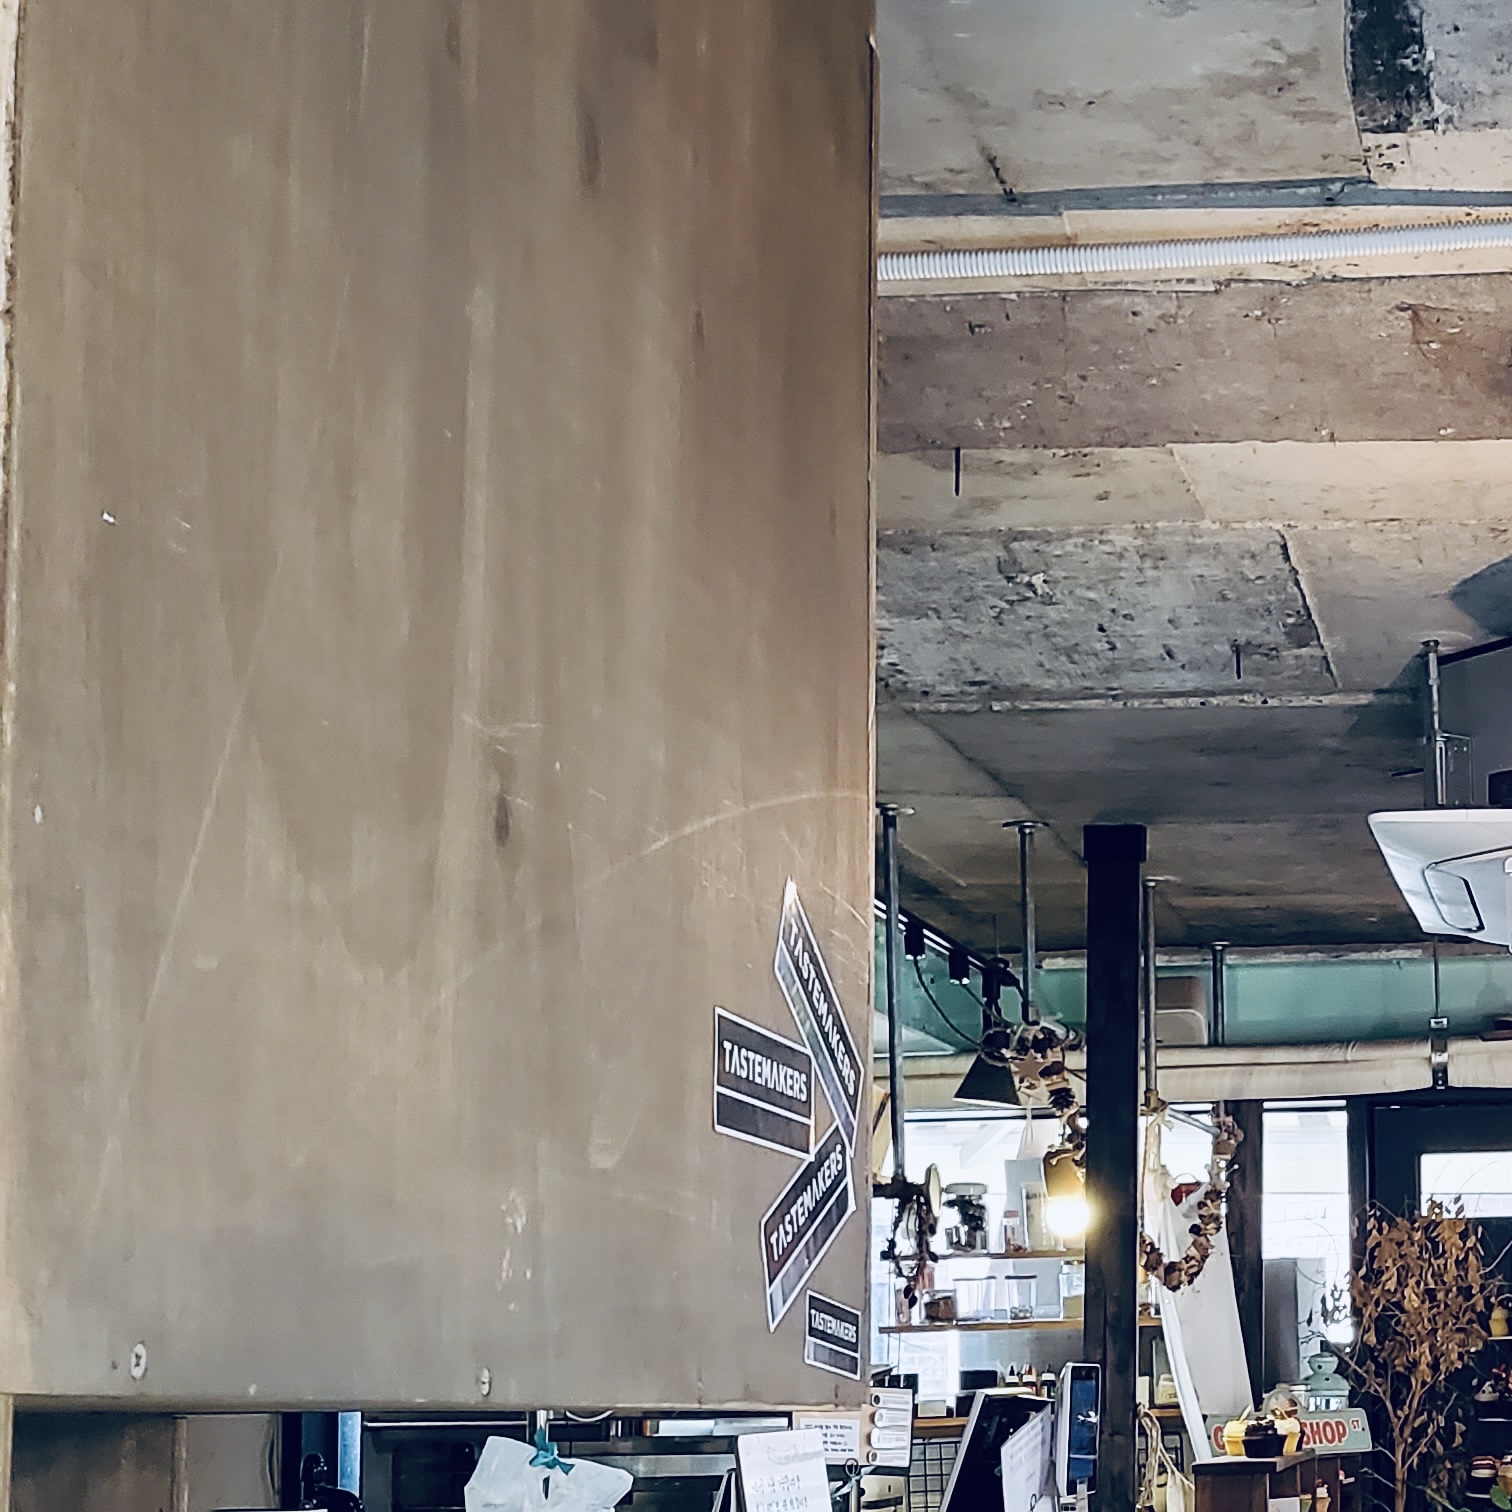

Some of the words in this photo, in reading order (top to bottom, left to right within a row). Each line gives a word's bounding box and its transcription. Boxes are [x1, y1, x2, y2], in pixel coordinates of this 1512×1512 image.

[789, 917, 856, 1096] TASTEMAKERS
[723, 1041, 808, 1102] TASTEMAKERS
[770, 1143, 843, 1261] TASTEMAKERS
[810, 1308, 857, 1344] TASTEMAKERS
[1300, 1419, 1347, 1446] SHOP
